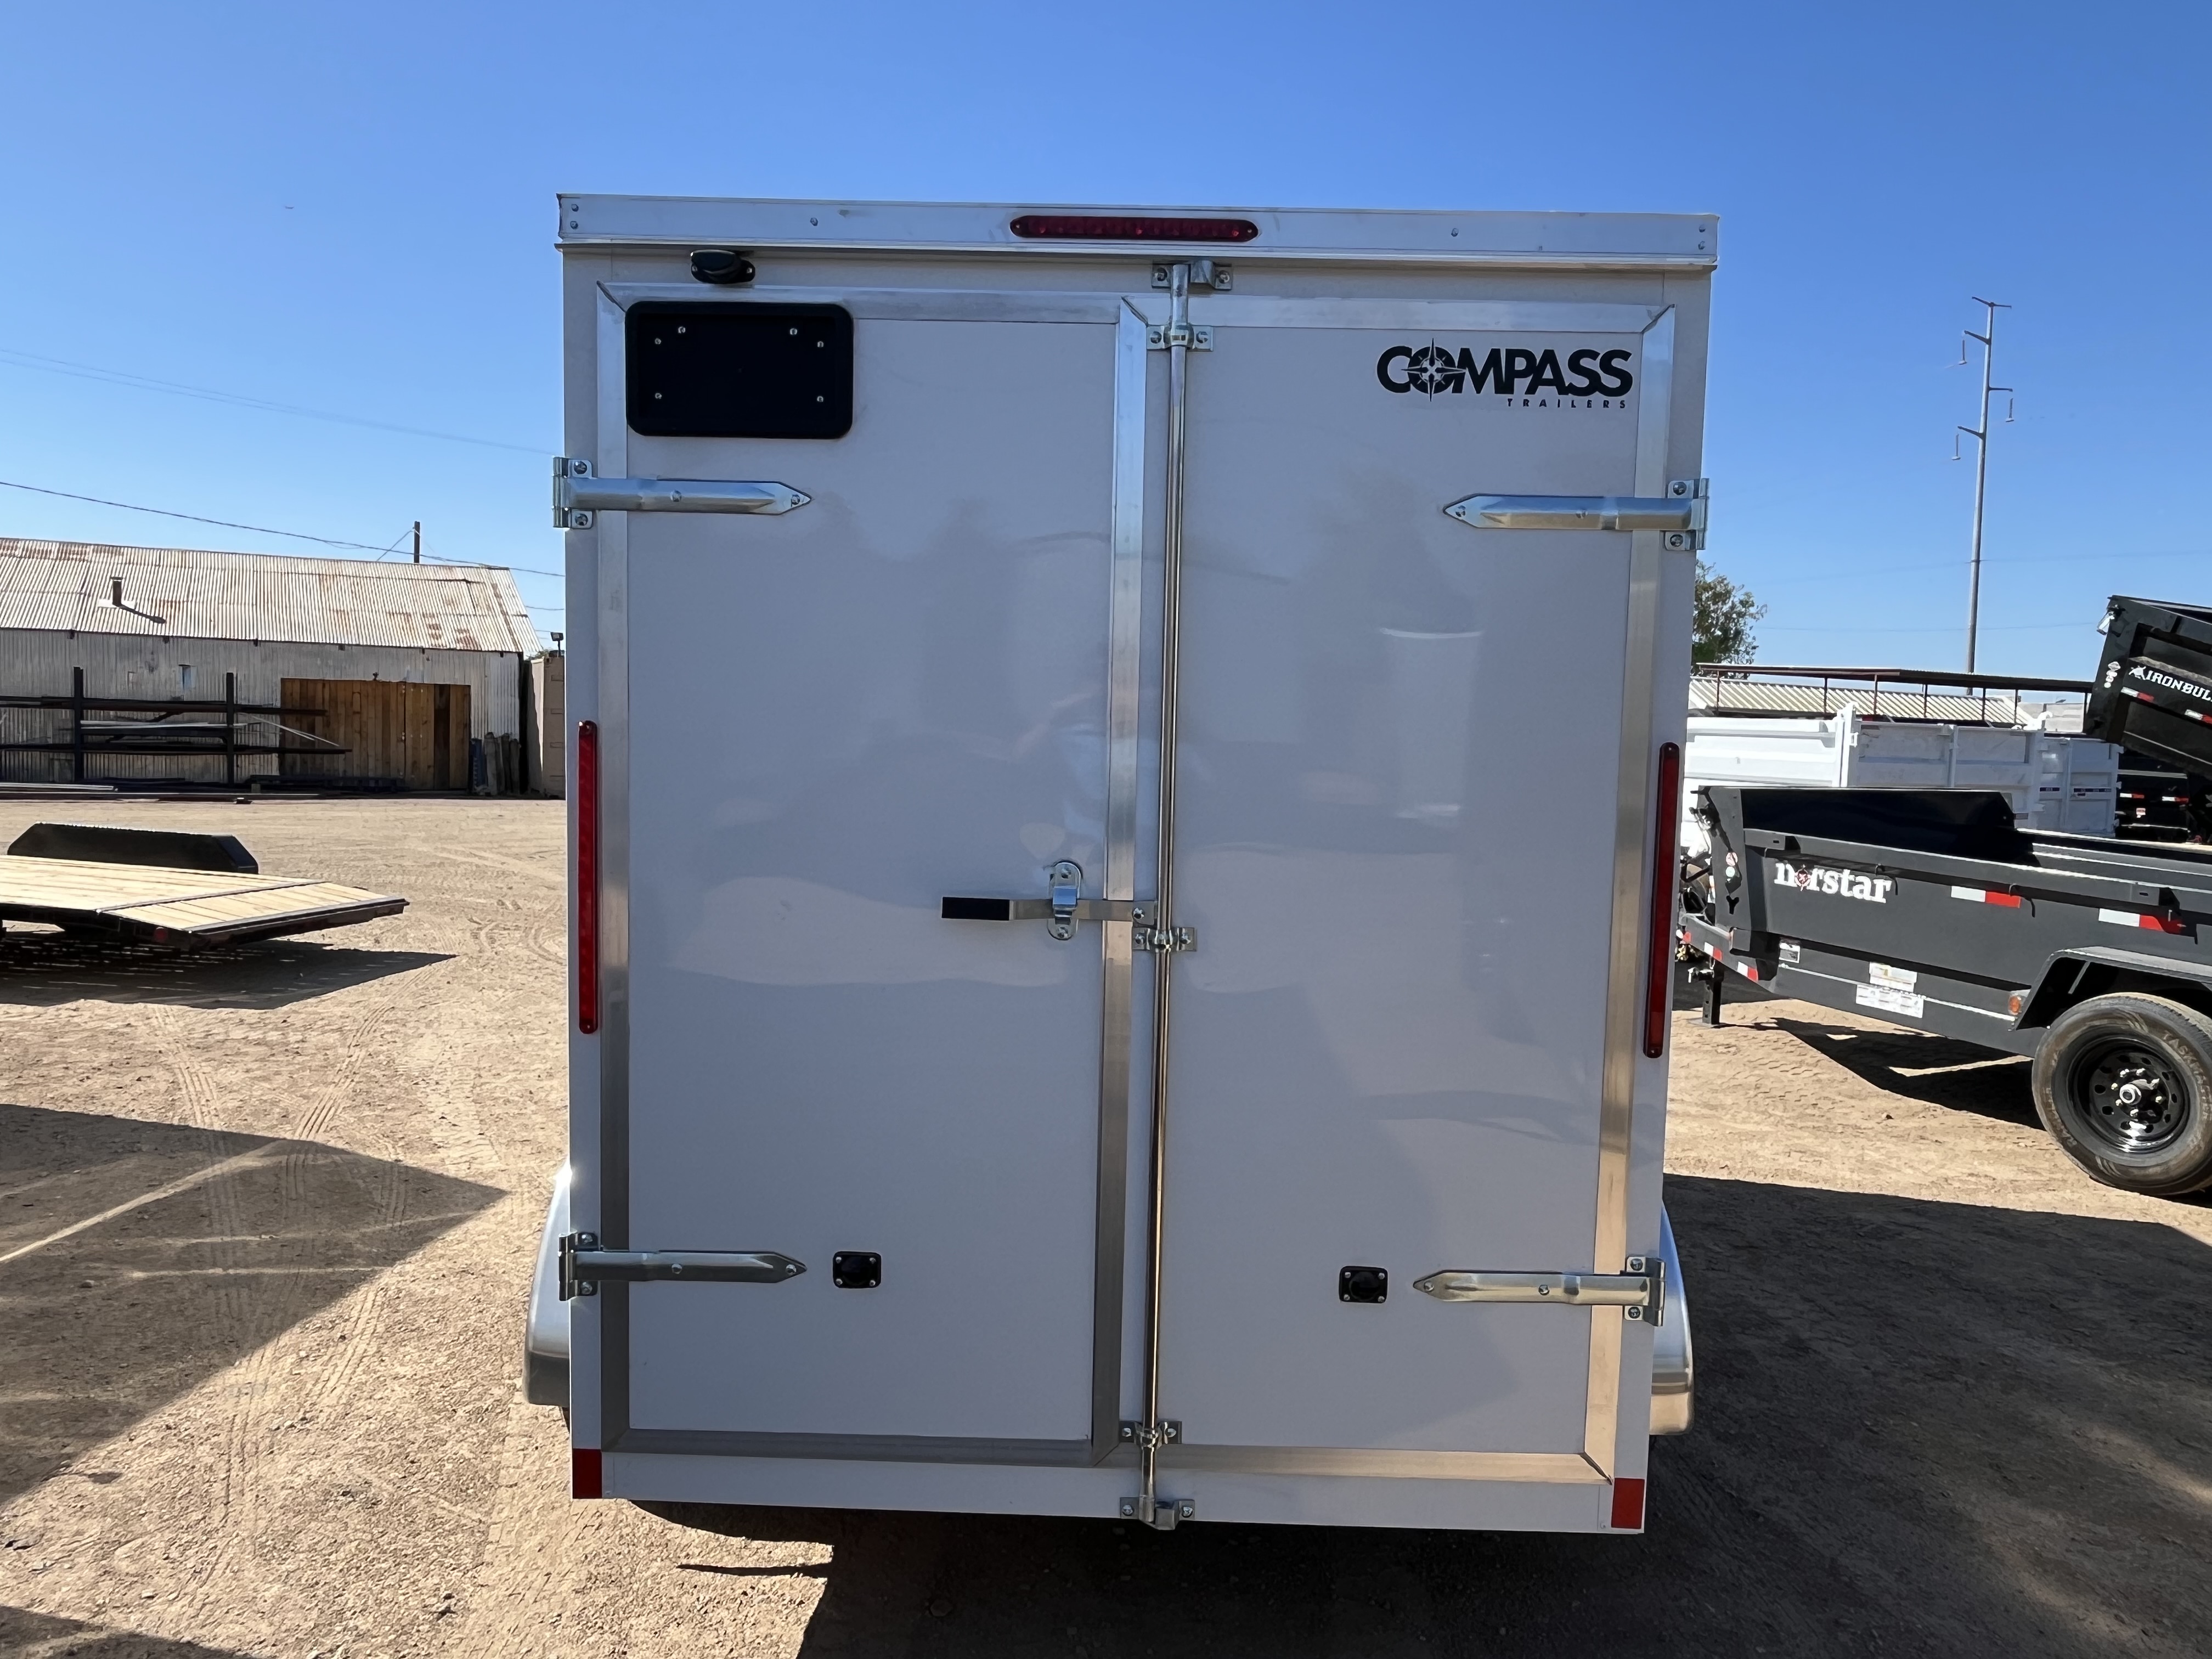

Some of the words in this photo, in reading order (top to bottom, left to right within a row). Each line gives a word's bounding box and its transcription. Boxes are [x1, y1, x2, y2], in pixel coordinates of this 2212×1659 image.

[1376, 342, 1633, 398] COMPASS
[1507, 398, 1627, 409] TRAILERS
[2146, 670, 2212, 702] IRONBUL
[1774, 862, 1892, 904] norstar
